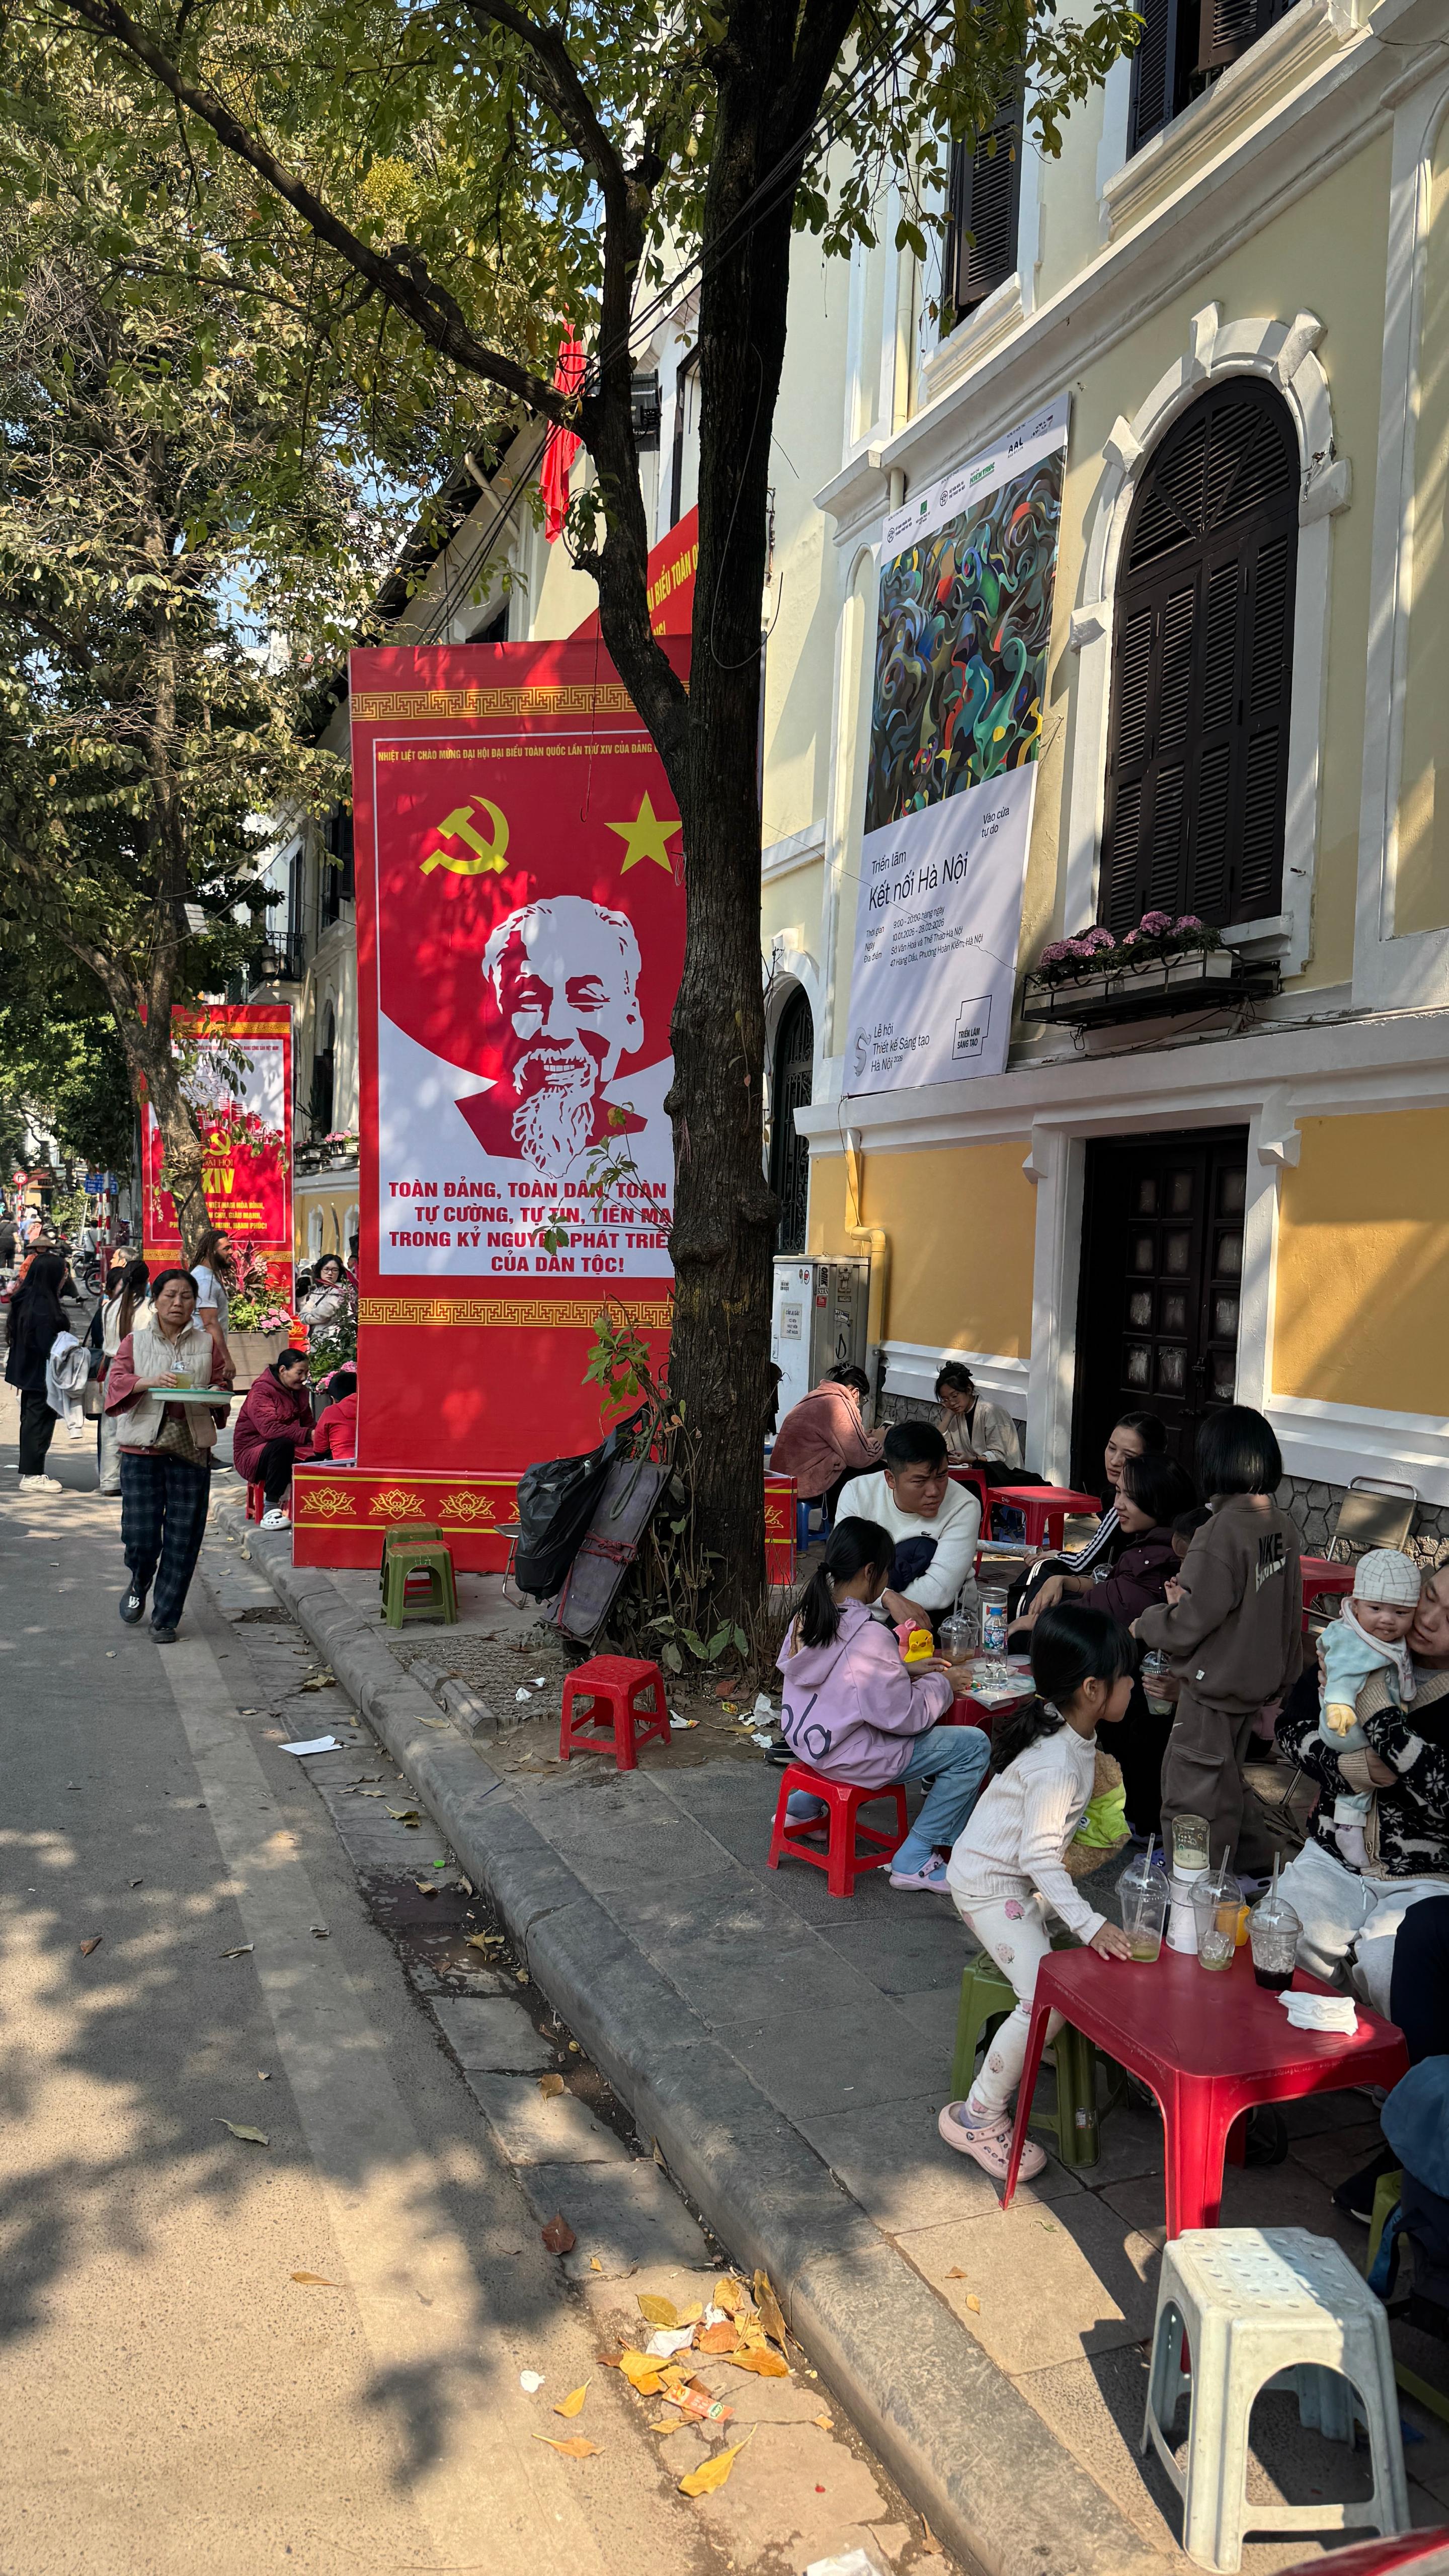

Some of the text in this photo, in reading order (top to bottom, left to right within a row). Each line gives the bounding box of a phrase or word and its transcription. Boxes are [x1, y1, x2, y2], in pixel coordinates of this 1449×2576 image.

[1008, 437, 1023, 454] AAL
[671, 550, 692, 590] TOÀN
[378, 750, 399, 763] NHIỆT
[401, 749, 416, 762] LIỆT
[418, 748, 437, 760] CHÀO
[439, 748, 461, 759] MỪNG
[463, 749, 475, 760] ĐẠI
[477, 747, 490, 760] HỘI
[492, 748, 504, 759] ĐẠI
[506, 744, 522, 757] BIỂU
[525, 745, 543, 756] TOÀN
[546, 743, 566, 757] QUỐC
[568, 743, 582, 755] LẦN
[584, 743, 599, 754] THỨ
[600, 745, 612, 754] XIV
[615, 741, 629, 753] CỦA
[631, 740, 652, 753] ĐẢNG
[983, 807, 1010, 824] Vào cửa
[982, 824, 999, 838] tự do
[872, 851, 907, 875] Triển lãm
[869, 851, 968, 911] Kết nối Hà Nội
[946, 929, 953, 938] Hà
[966, 936, 973, 946] Hà
[874, 1023, 894, 1038] Lễ hội
[873, 1035, 930, 1055] Thiết kế Sáng tạo
[871, 1059, 880, 1072] Hà
[881, 1057, 893, 1072] Nội
[201, 1168, 234, 1194] XIV
[389, 1179, 438, 1197] TOÀN
[444, 1176, 501, 1199] ĐẢNG,
[508, 1179, 557, 1198] TOÀN
[616, 1180, 667, 1198] TOÀN
[415, 1205, 440, 1225] TỰ
[444, 1203, 514, 1224] CƯỜNG,
[520, 1206, 545, 1226] TỰ
[549, 1207, 585, 1224] TIN,
[389, 1232, 451, 1247] TRONG
[457, 1226, 481, 1247] KỶ
[570, 1230, 619, 1248] PHÁT
[491, 1250, 624, 1275] CỦA DÂN TỘC!
